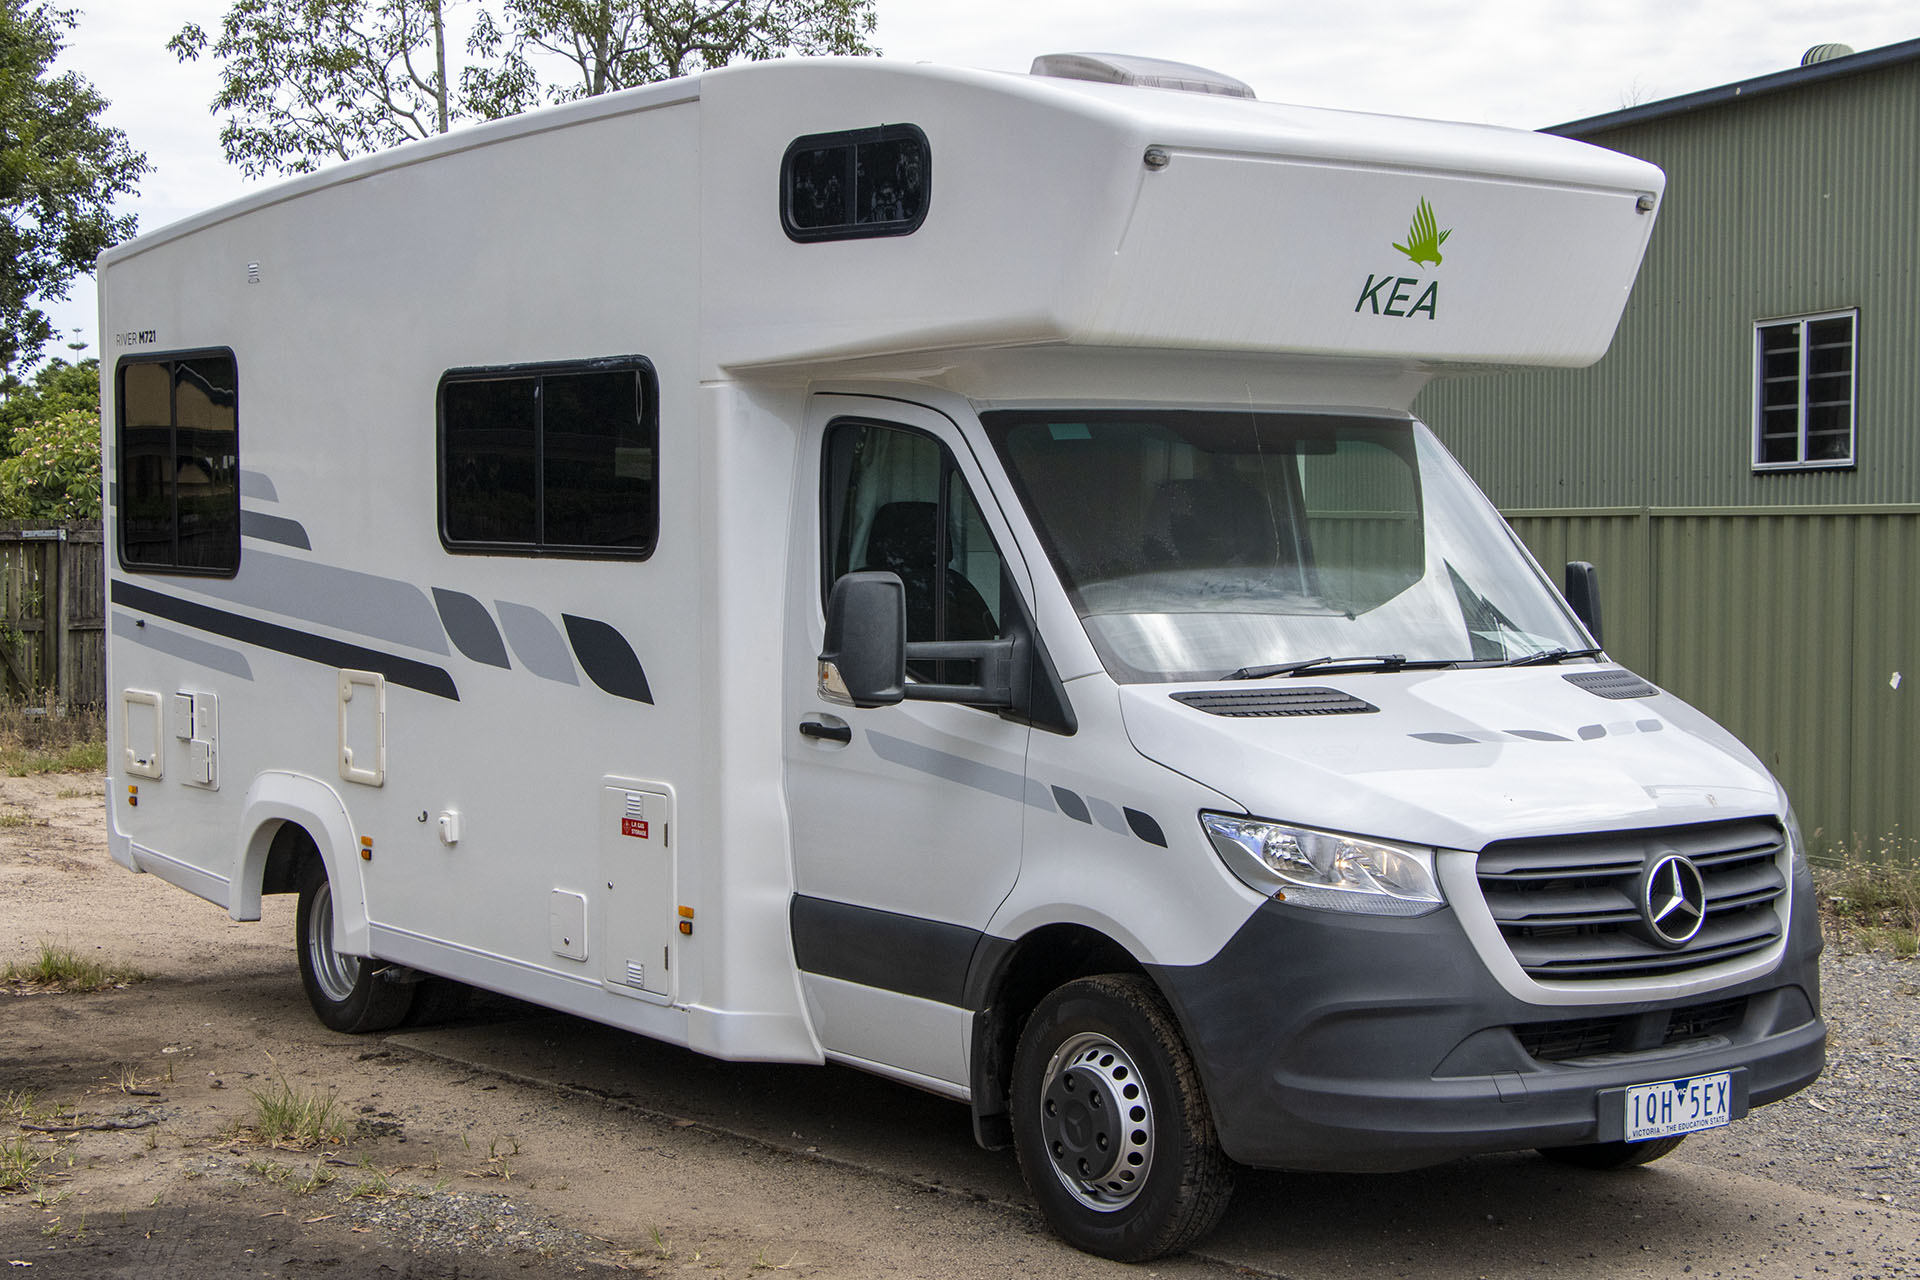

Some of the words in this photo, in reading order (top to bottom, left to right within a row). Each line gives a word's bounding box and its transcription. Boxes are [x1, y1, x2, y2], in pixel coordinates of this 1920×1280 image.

[1354, 273, 1438, 320] KEA
[116, 332, 137, 346] RIVER
[138, 330, 156, 344] M721
[1634, 1090, 1673, 1128] 1QH
[1691, 1081, 1727, 1118] 5EX
[1632, 1127, 1660, 1137] VICTORIA
[1678, 1119, 1709, 1130] EDUCATION
[1710, 1115, 1725, 1125] STATE
